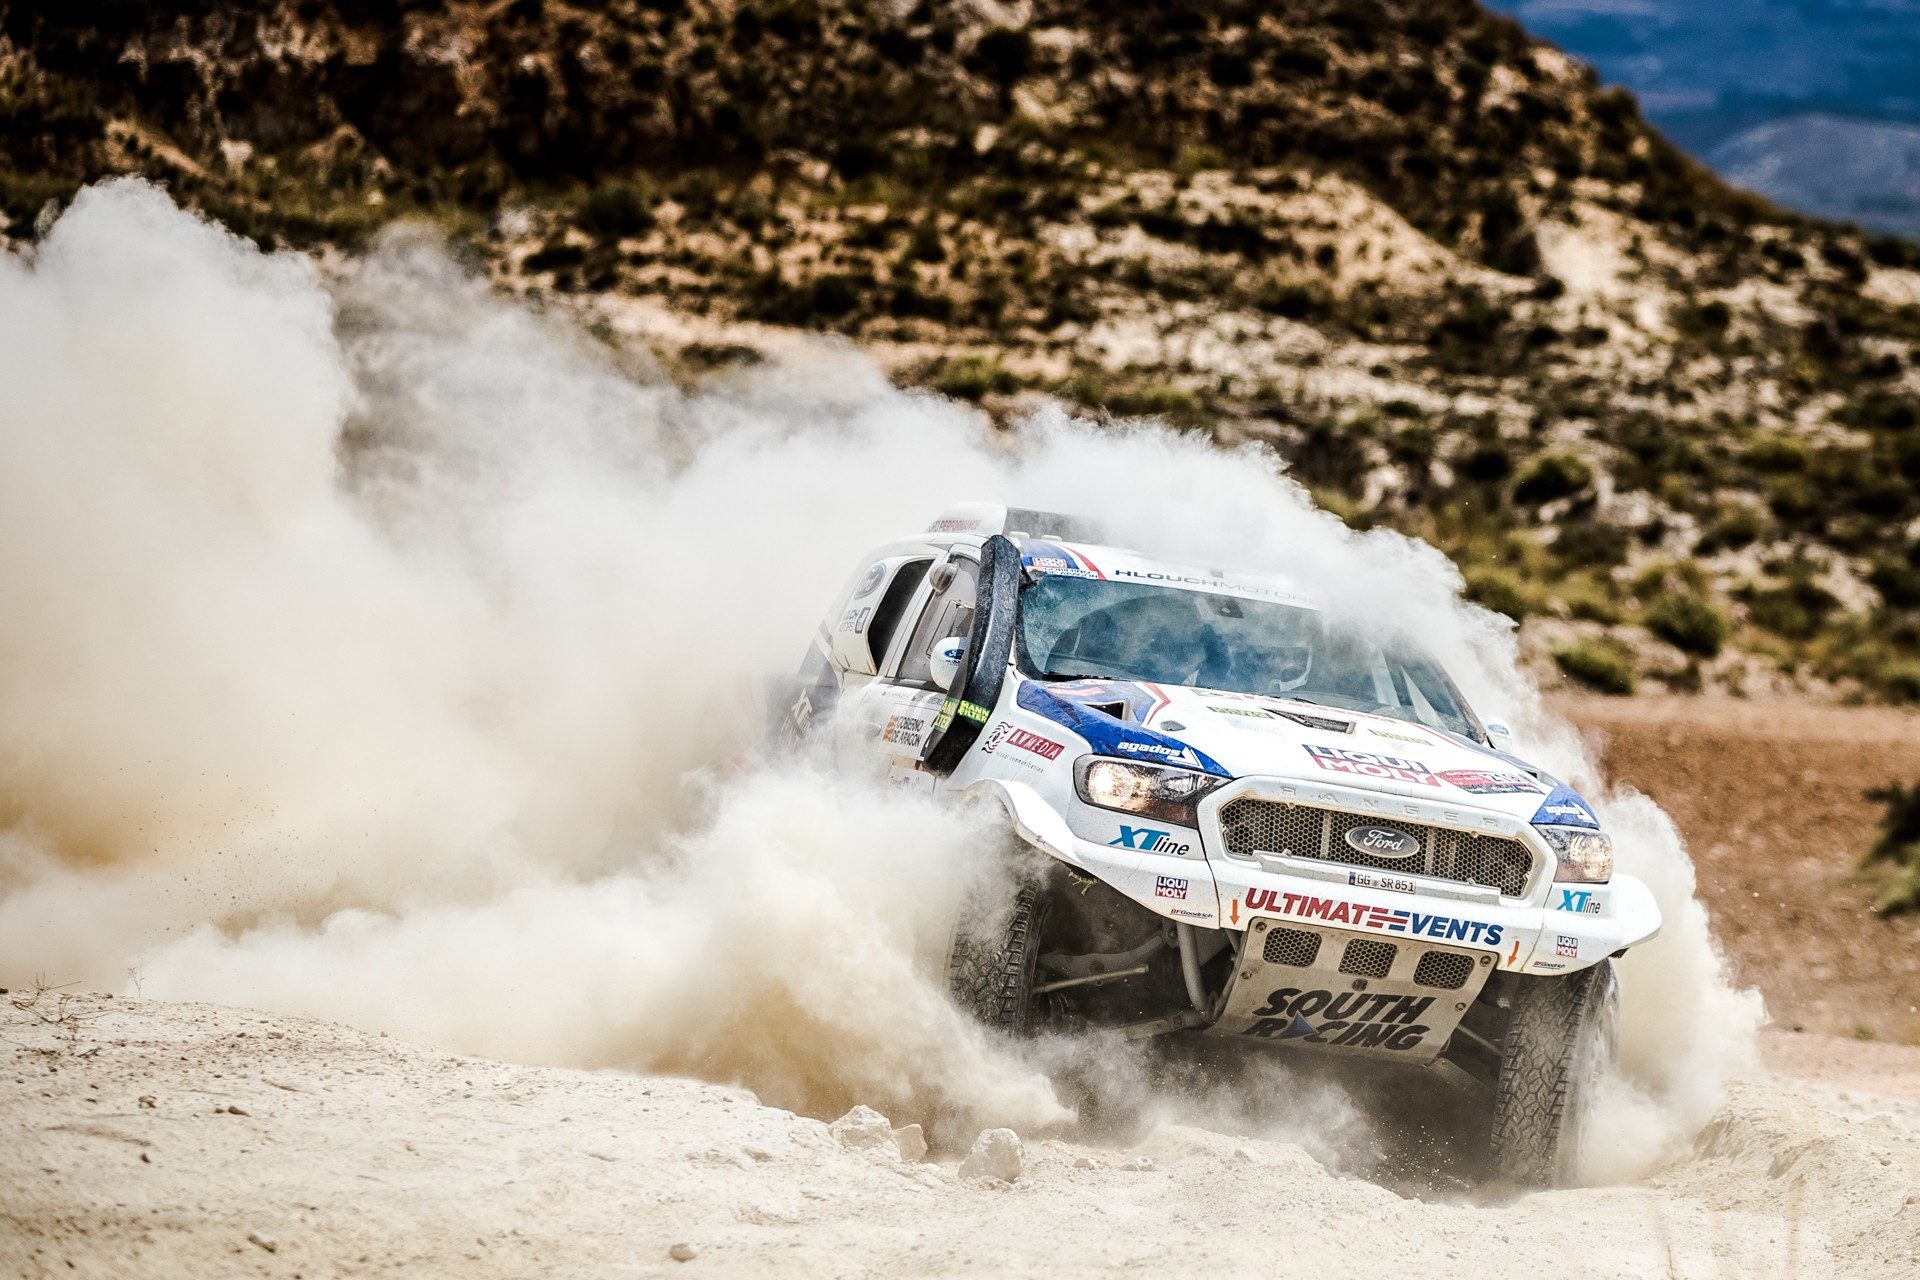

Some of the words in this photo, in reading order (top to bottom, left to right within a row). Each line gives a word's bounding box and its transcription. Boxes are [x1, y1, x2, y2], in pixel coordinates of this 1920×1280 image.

[958, 707, 988, 724] FILTER
[959, 699, 990, 718] MANN
[896, 716, 925, 733] GOBIERNO
[1009, 731, 1061, 760] AVMEDIA
[1117, 741, 1182, 757] agados
[1306, 744, 1430, 774] LIQUI
[1316, 756, 1438, 786] MOLY
[1280, 785, 1499, 829] RANGER
[1107, 824, 1190, 856] XTline
[1363, 829, 1403, 852] Ford
[1157, 876, 1188, 890] LIQUI
[1356, 873, 1371, 886] GG
[1156, 886, 1187, 899] MOLY
[1556, 889, 1601, 914] XTline
[1557, 935, 1578, 948] LIQUI
[1556, 945, 1578, 958] MOLY
[1252, 987, 1437, 1025] SOUTH
